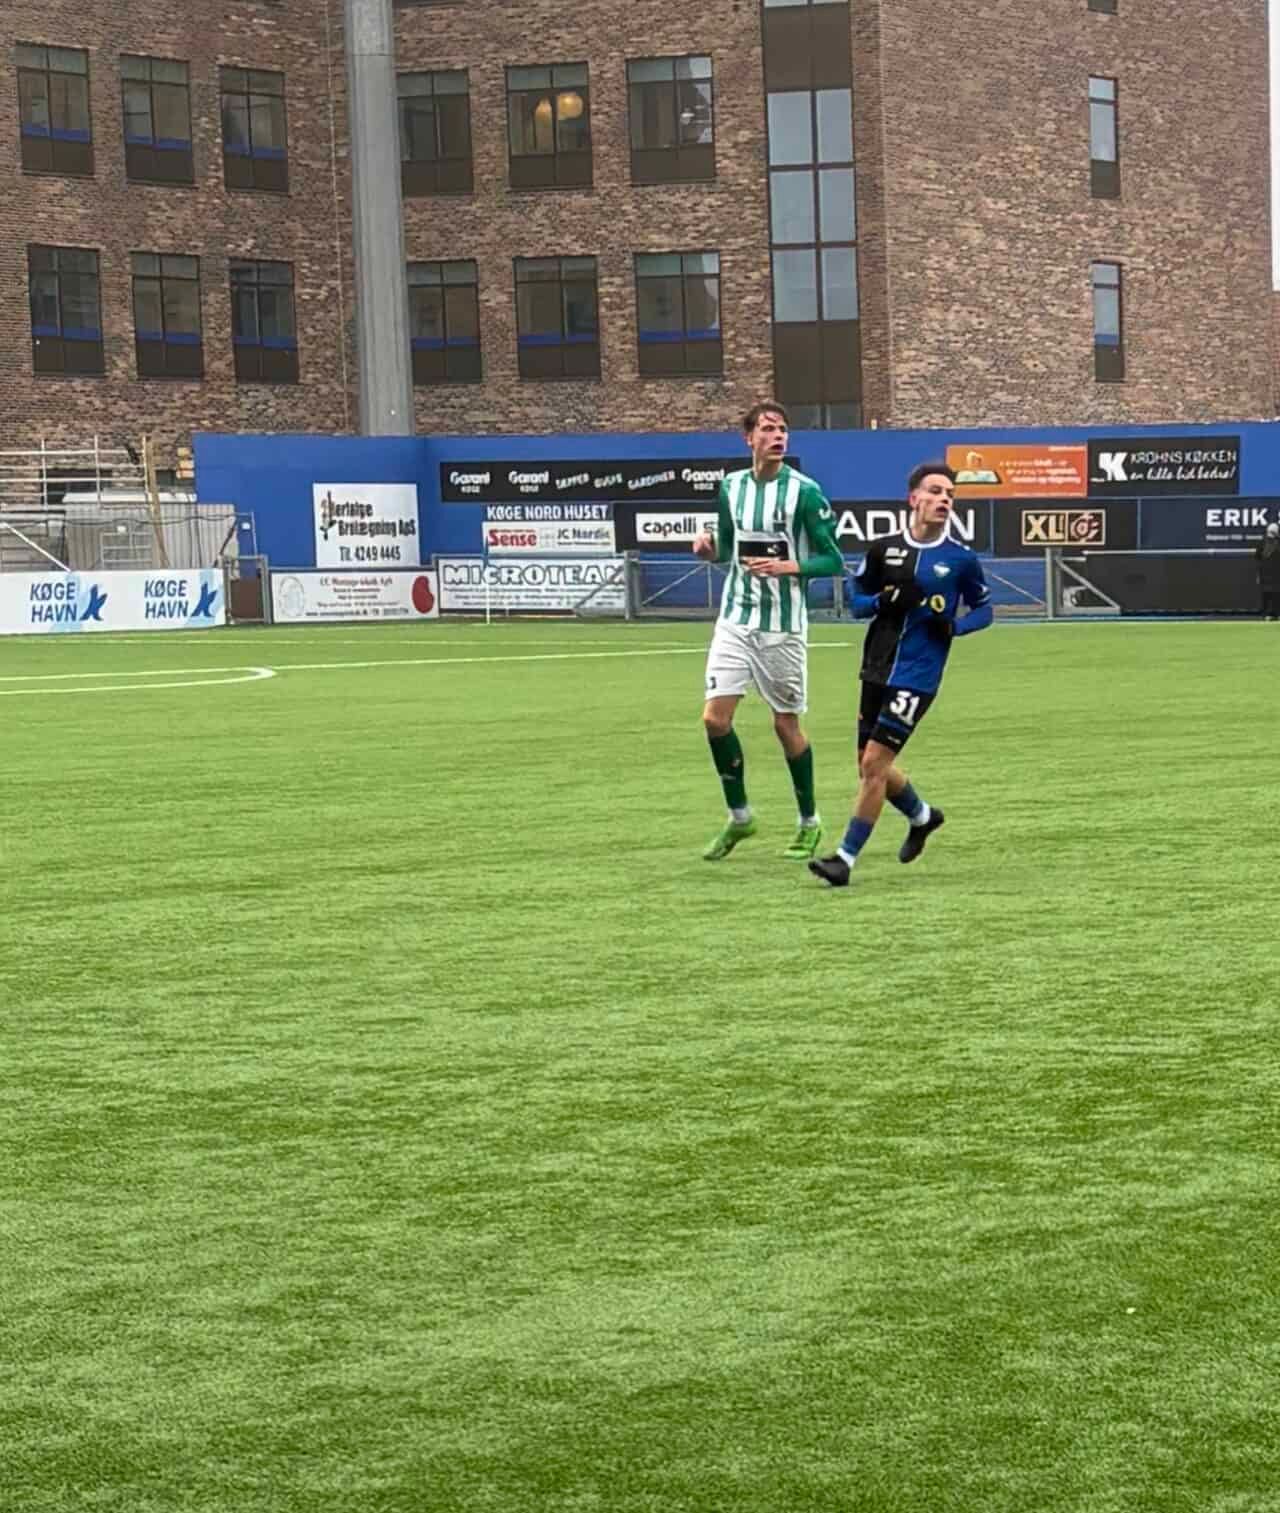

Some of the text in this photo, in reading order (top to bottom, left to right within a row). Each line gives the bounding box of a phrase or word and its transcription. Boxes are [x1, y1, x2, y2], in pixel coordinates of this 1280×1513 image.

[1130, 451, 1182, 464] KROHNS
[1184, 450, 1236, 463] KØKKEN
[487, 505, 608, 520] KØGE NORD HUSET
[1206, 508, 1268, 526] ERIK
[642, 517, 697, 537] capelli
[488, 528, 538, 547] Sense
[355, 546, 378, 561] 4249
[30, 582, 75, 600] KØGE
[144, 580, 188, 598] KØGE
[31, 604, 77, 622] HAVN
[145, 600, 189, 619] HAVN
[890, 690, 920, 726] 31
